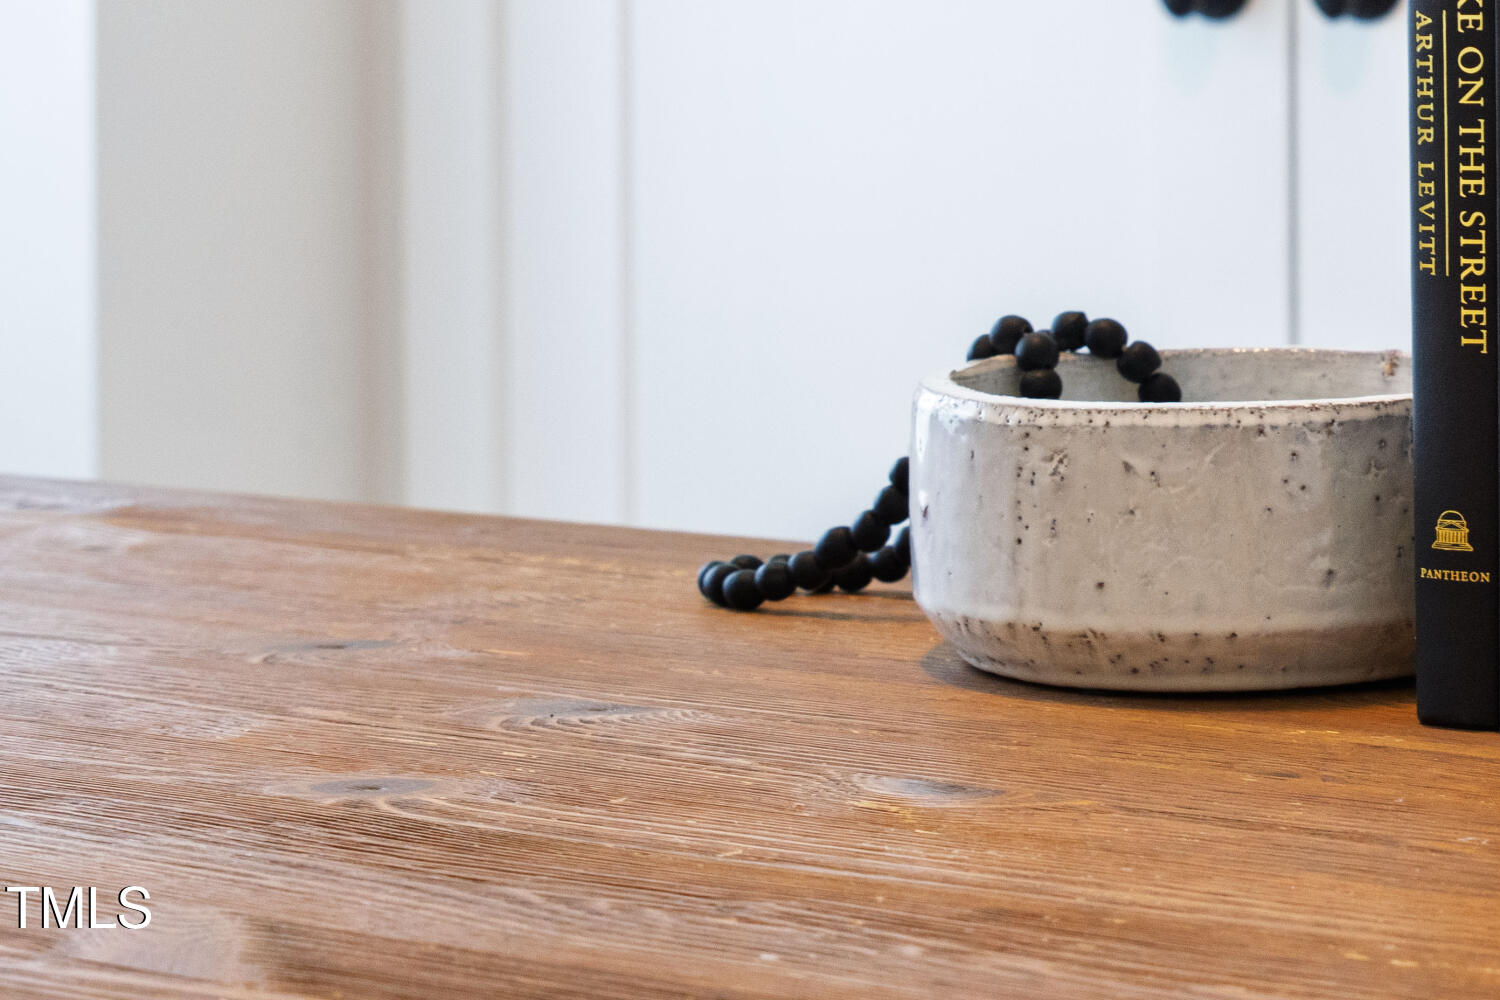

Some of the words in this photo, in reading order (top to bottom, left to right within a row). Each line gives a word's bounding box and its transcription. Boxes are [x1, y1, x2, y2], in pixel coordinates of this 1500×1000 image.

[1415, 10, 1435, 146] ARTHUR
[1457, 46, 1485, 107] ON
[1458, 118, 1486, 198] THE
[1417, 160, 1437, 277] LEVITT
[1459, 210, 1488, 354] STREET
[1420, 567, 1491, 583] PANTHEON
